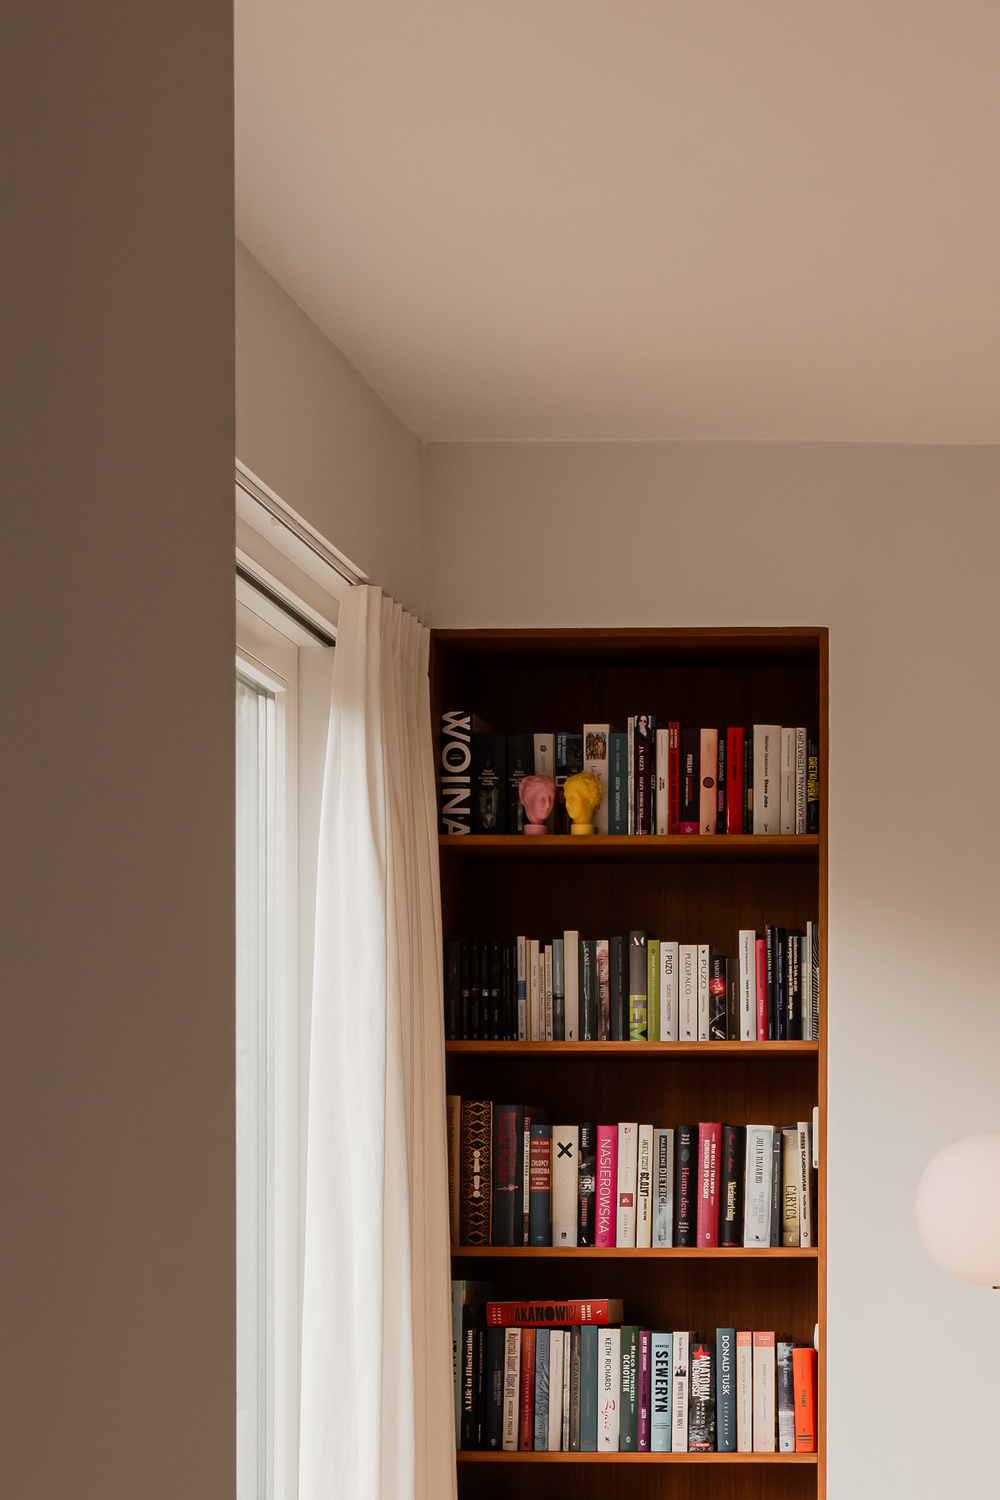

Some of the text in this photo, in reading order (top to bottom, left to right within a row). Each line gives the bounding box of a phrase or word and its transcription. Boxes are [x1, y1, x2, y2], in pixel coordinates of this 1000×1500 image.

[629, 995, 647, 1042] LEM
[497, 1113, 508, 1182] dzieje Polski
[508, 1112, 518, 1177] Ilustrowane
[756, 1136, 764, 1155] JULIA
[579, 1174, 592, 1196] 1956
[599, 1138, 611, 1234] NASIEROWSKA
[659, 1167, 667, 1209] DIETRICH
[681, 1166, 690, 1195] Homo
[703, 1169, 710, 1177] PO
[755, 1156, 764, 1184] NAVARRO
[681, 1197, 689, 1218] deus
[785, 1185, 797, 1221] CARYCA
[506, 1305, 577, 1323] ABAKANOWICZ
[604, 1337, 612, 1356] KEITH
[722, 1335, 730, 1372] DONALD
[464, 1330, 474, 1413] A Life in Illustration
[604, 1358, 612, 1392] RICHARDS
[622, 1354, 630, 1393] OCHOTNIK
[655, 1351, 669, 1413] SEWERYN
[699, 1355, 710, 1401] ANATOMIA
[722, 1373, 730, 1395] TUSK
